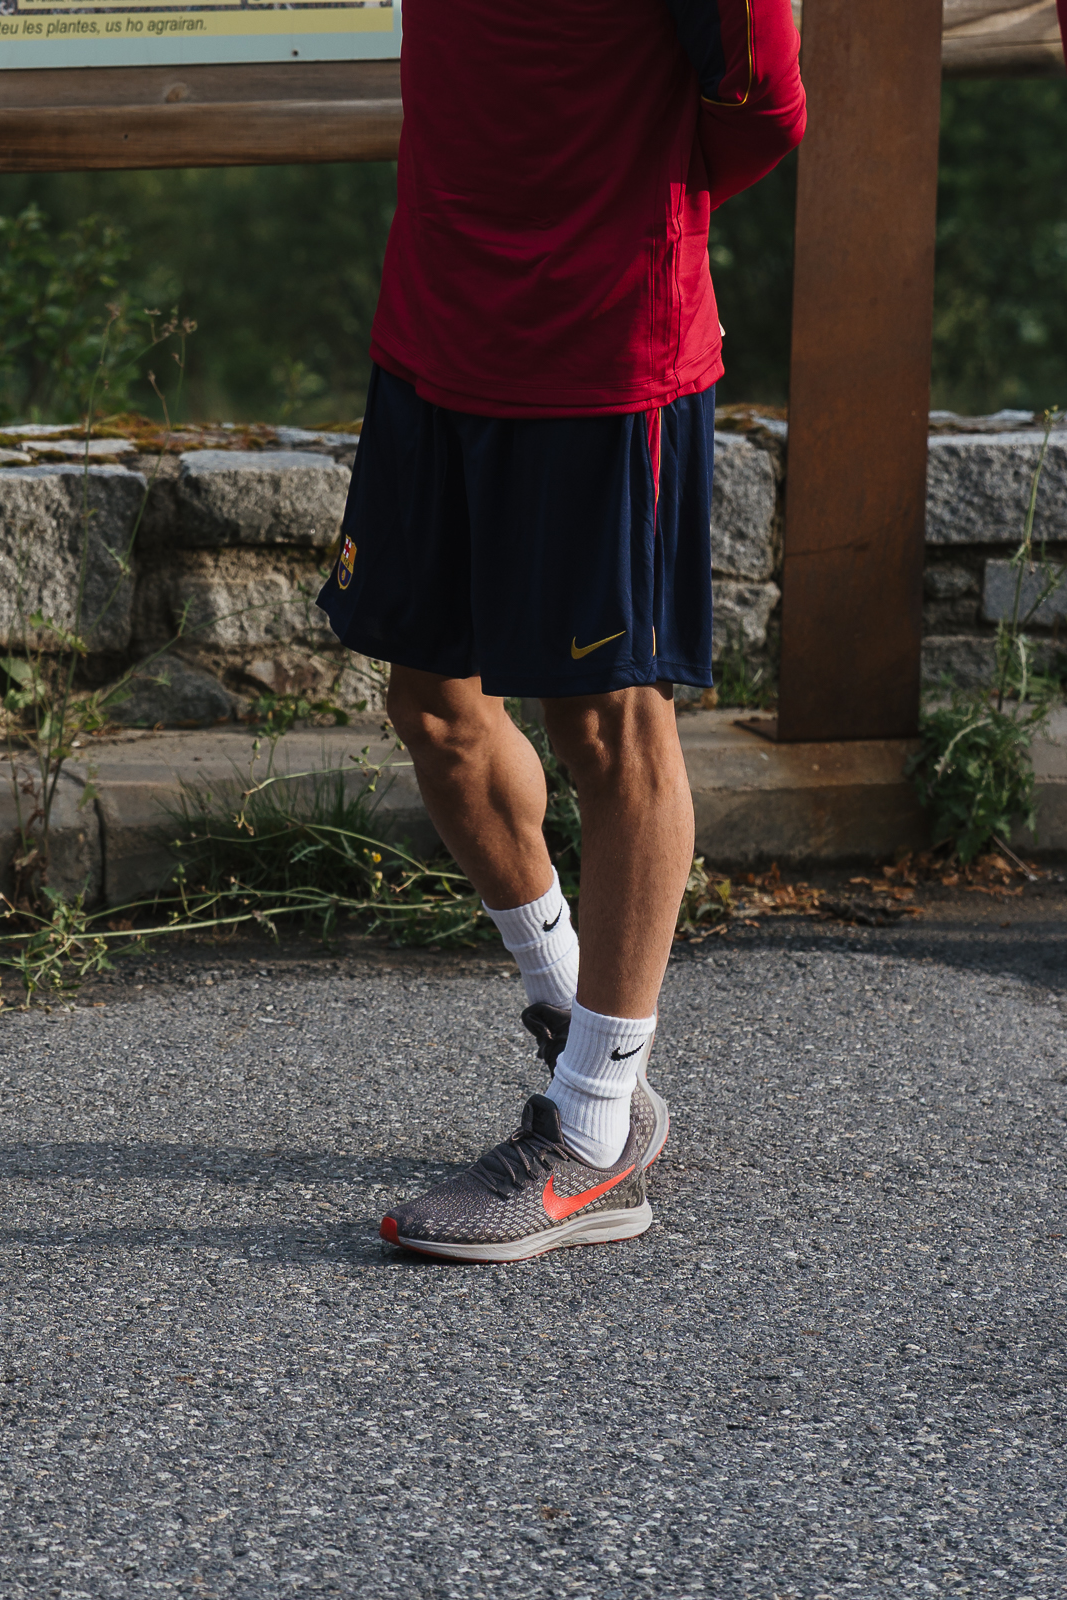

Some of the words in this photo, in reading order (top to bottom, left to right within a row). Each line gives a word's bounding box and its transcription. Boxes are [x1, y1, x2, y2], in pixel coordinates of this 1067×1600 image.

[22, 19, 43, 35] les
[46, 18, 100, 38] plantes,
[105, 19, 122, 33] us
[126, 17, 143, 32] ho
[147, 15, 207, 36] agrairan.
